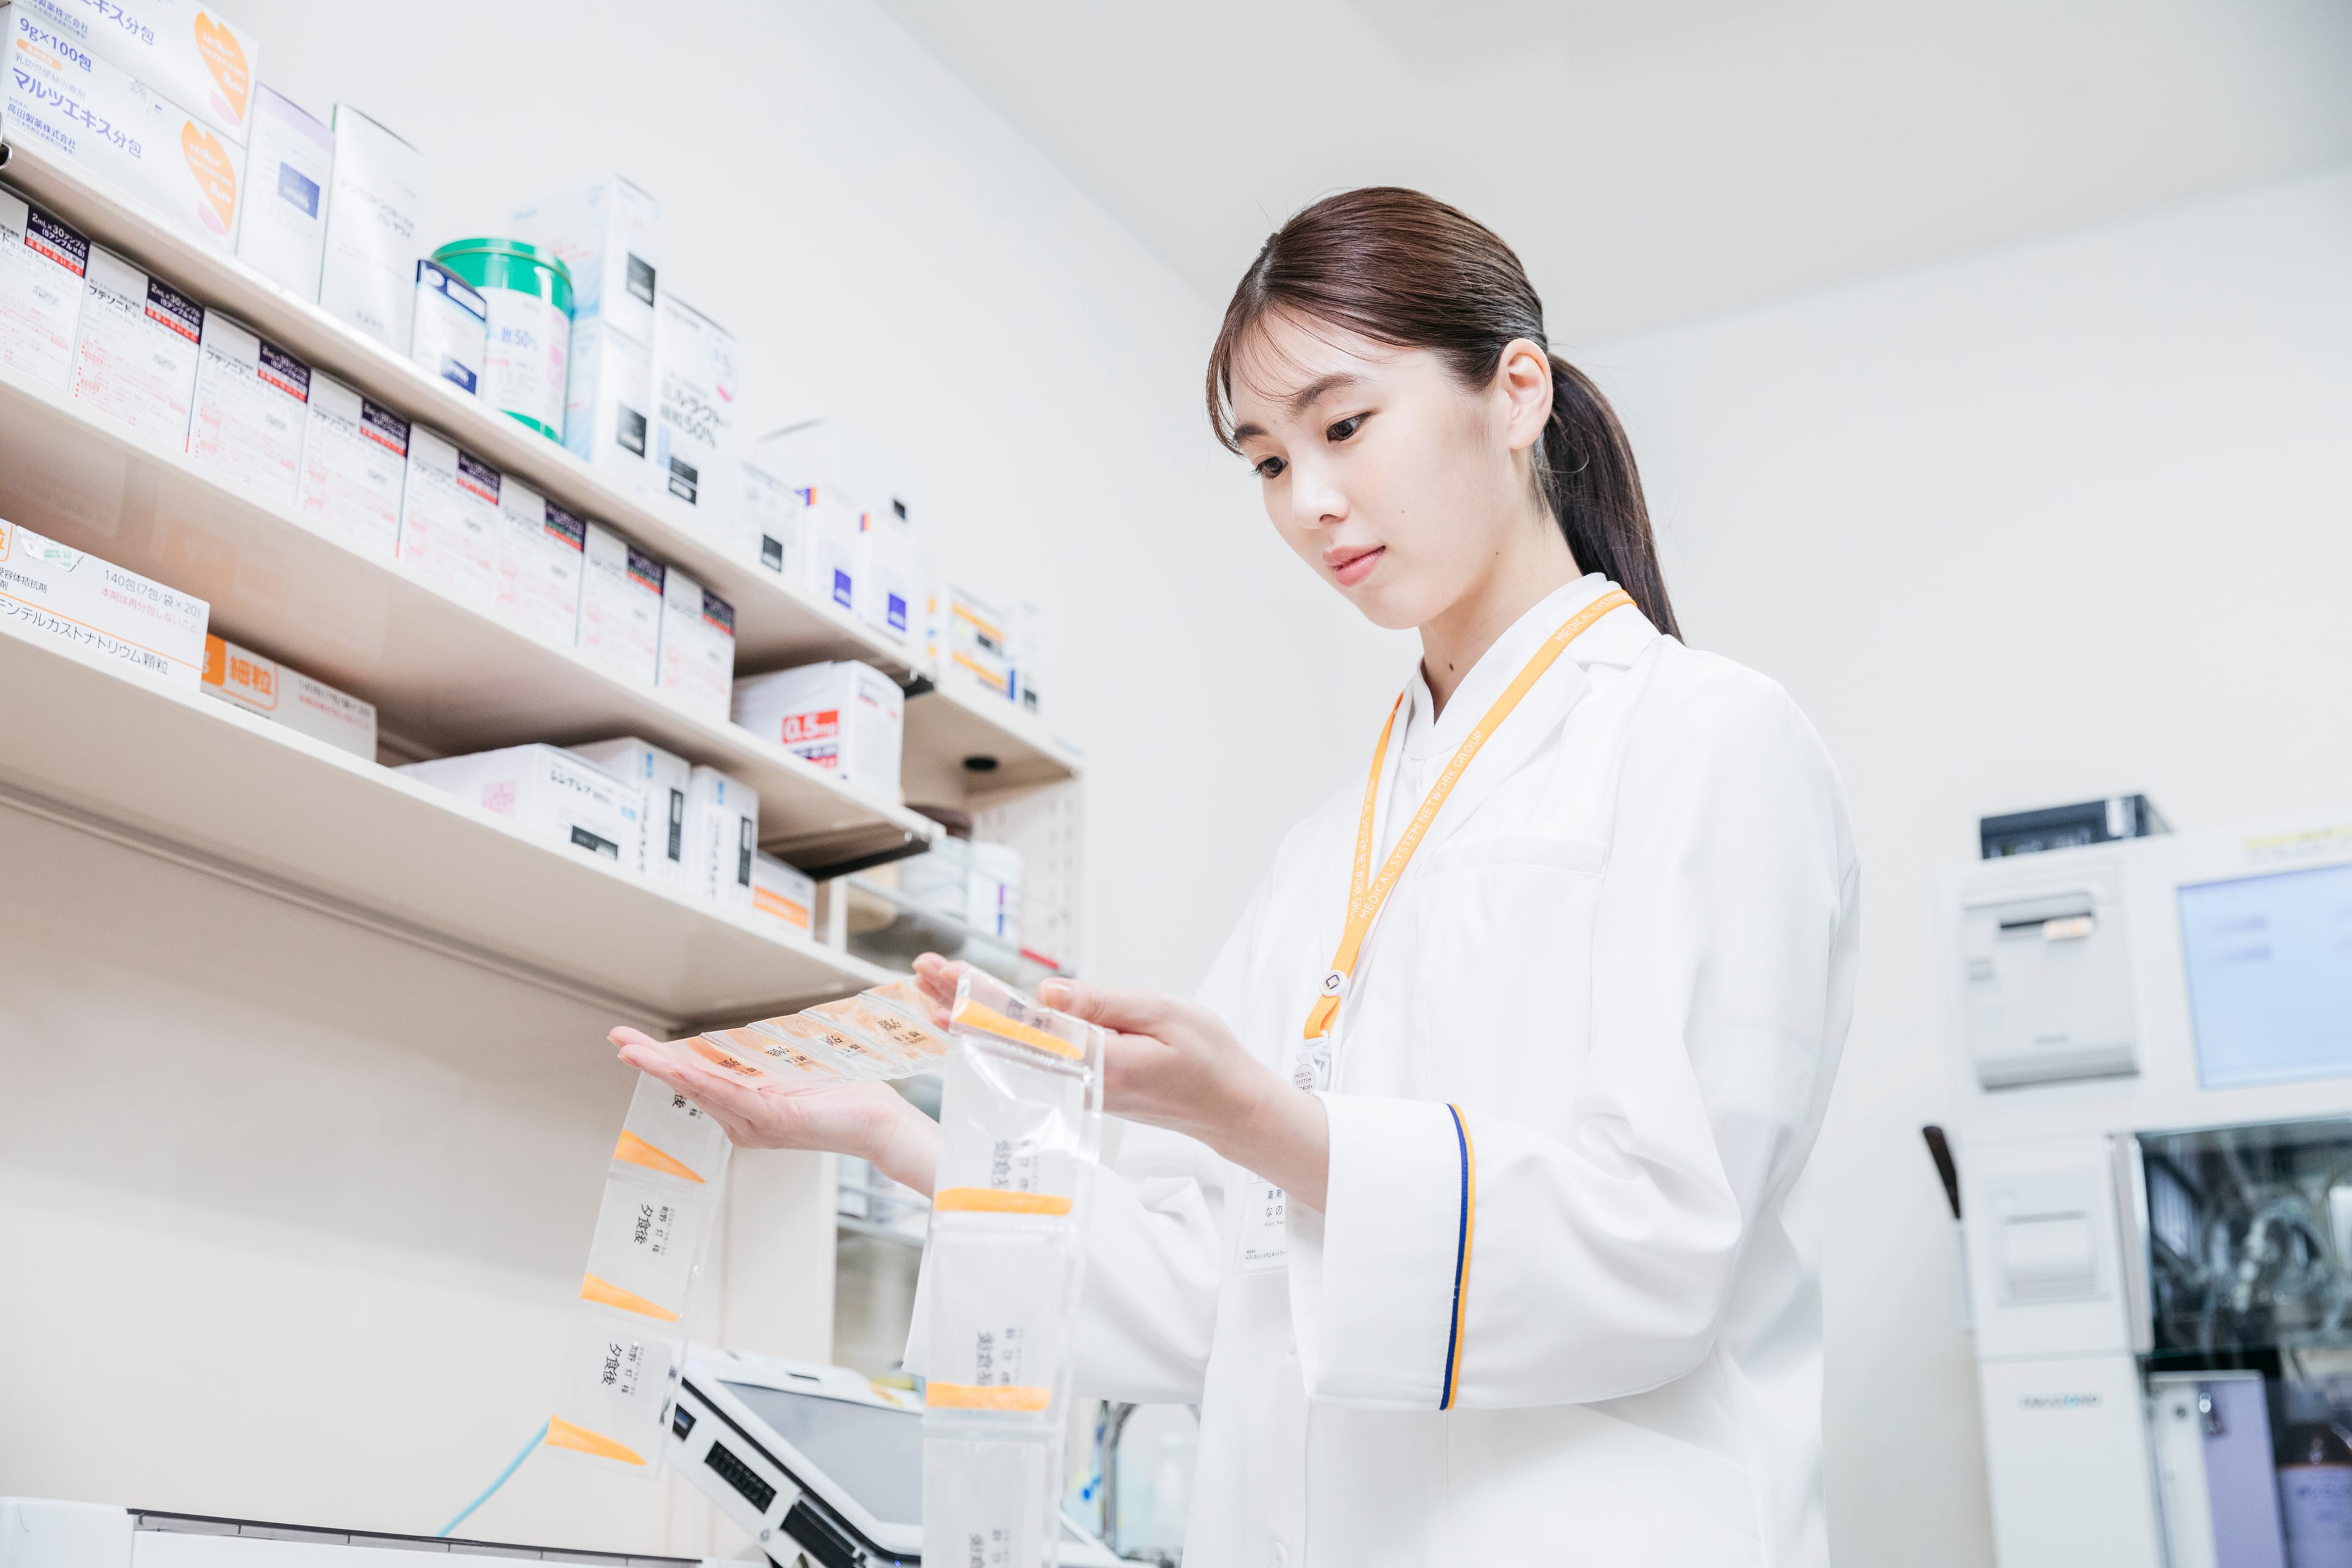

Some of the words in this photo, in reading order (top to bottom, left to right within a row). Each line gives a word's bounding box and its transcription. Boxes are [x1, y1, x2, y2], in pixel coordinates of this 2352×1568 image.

[29, 0, 89, 33] 製薬株式会社
[7, 103, 76, 149] 高田製薬株式会社
[13, 67, 141, 159] マルツエキス分包
[28, 239, 81, 273] 注射しないこと
[101, 589, 198, 634] 本剤は再分包しないこと
[104, 570, 201, 617] 140包(7包/袋×20)
[1555, 611, 1596, 642] MEDICAL
[230, 655, 271, 696] 細粒
[785, 714, 835, 739] 0.5mg
[1359, 867, 1395, 919] MEDICAL
[1390, 823, 1421, 869] SYSTEM
[1418, 771, 1457, 823] NETWORK
[1454, 731, 1483, 768] GROUP
[633, 1204, 654, 1245] 夕食後
[1265, 1205, 1283, 1217] なの
[601, 1343, 623, 1386] 夕食後
